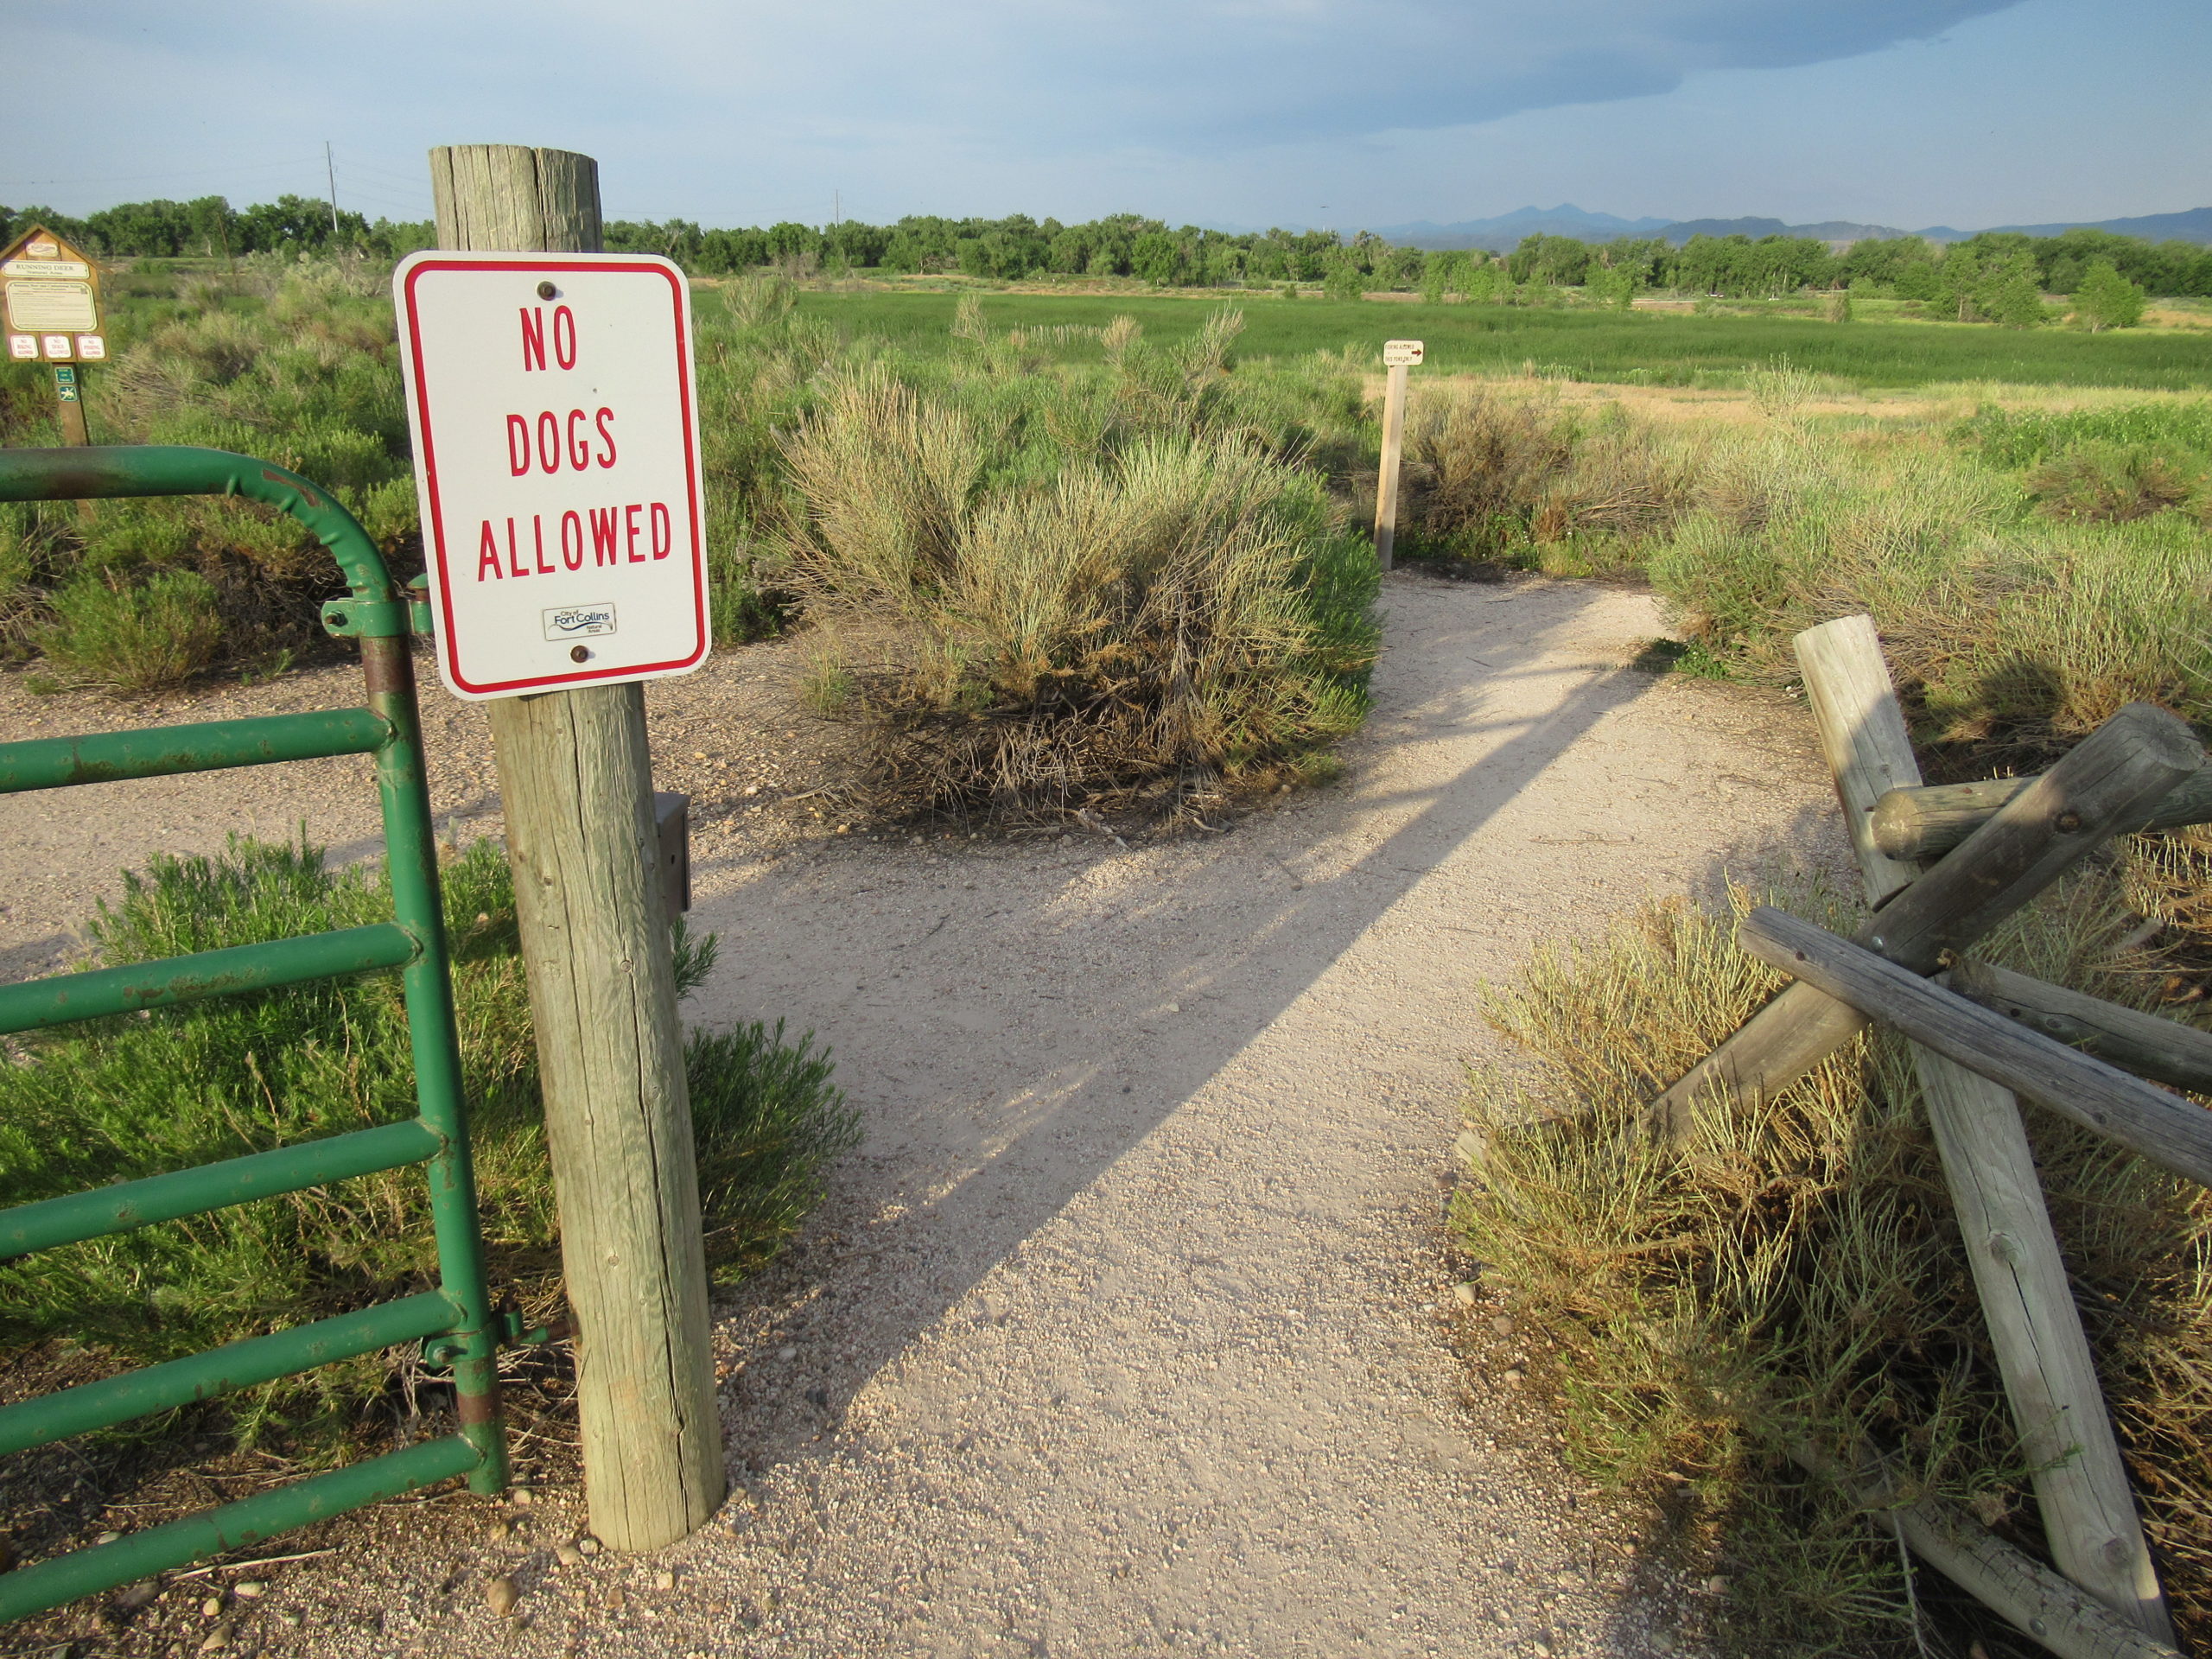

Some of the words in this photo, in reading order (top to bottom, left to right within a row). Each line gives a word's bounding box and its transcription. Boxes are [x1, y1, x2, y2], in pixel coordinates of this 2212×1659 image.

[519, 305, 577, 372] NO
[506, 407, 617, 477] DOGS
[478, 502, 671, 582] ALLOWED
[555, 615, 575, 625] Fort
[576, 612, 610, 622] Collins
